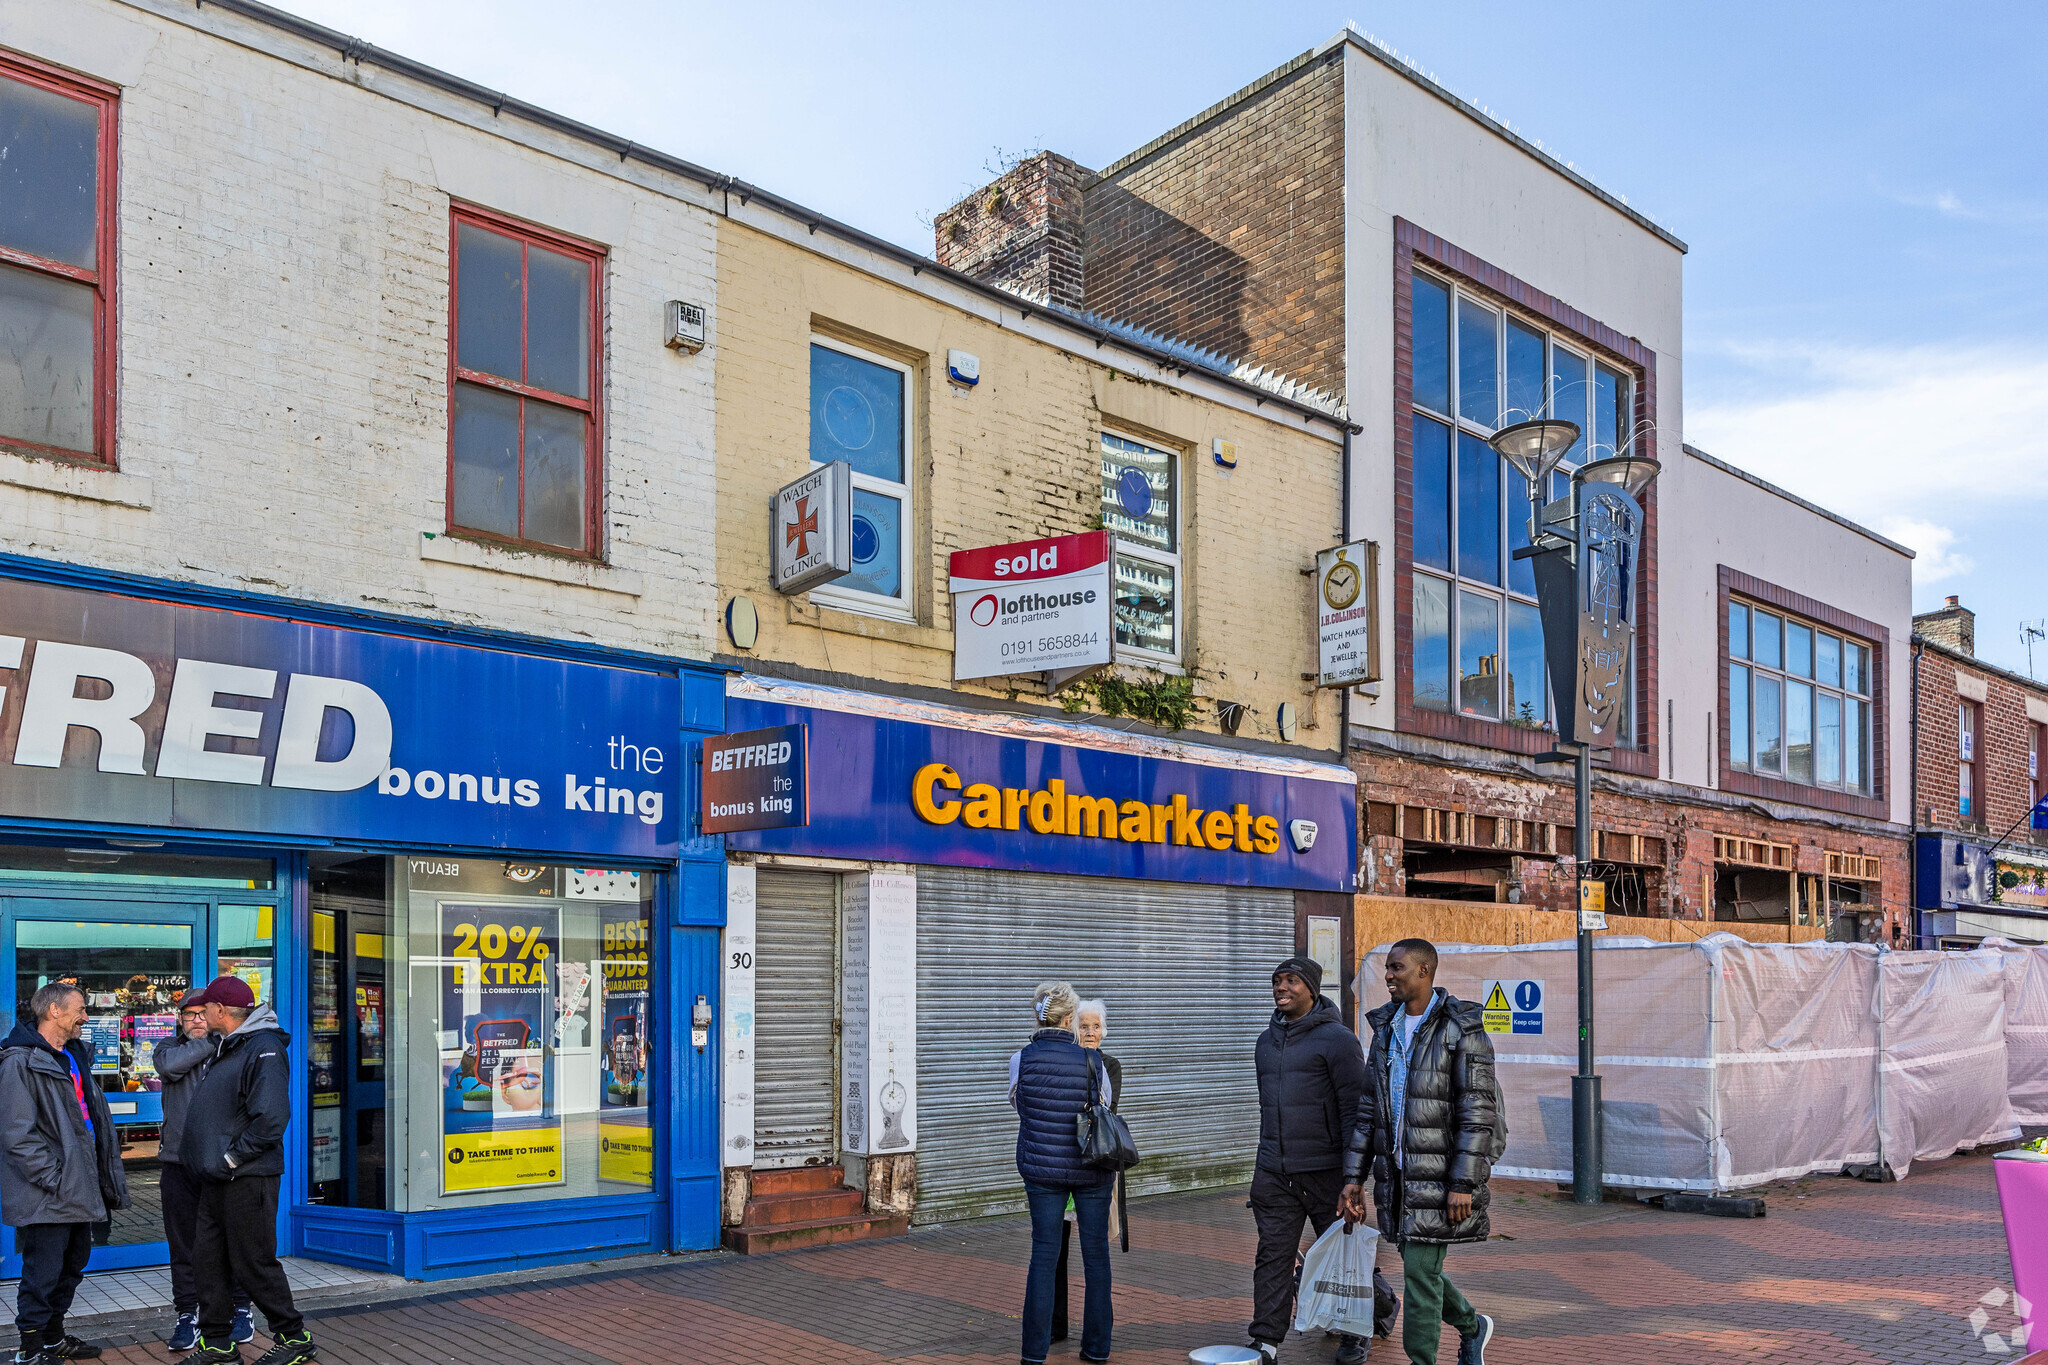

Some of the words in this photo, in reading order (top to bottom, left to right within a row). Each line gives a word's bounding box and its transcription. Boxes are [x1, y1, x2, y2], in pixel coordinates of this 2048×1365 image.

[680, 306, 701, 319] ABEL
[783, 474, 822, 503] WATCH
[788, 519, 815, 537] JEWELLERY
[783, 552, 822, 579] CLINIC
[994, 545, 1057, 576] sold
[1001, 590, 1096, 615] lofthouse
[1002, 615, 1018, 625] and
[1022, 610, 1060, 625] partners
[1130, 608, 1136, 618] &
[1139, 609, 1164, 624] WATCH
[1321, 631, 1343, 643] WATCH
[1345, 626, 1367, 638] MAKER
[1001, 640, 1032, 656] 0191
[1038, 632, 1098, 651] 5658844
[1337, 641, 1350, 651] AND
[1002, 650, 1090, 666] www.lofthouseandpartners.co.uk
[1331, 651, 1358, 664] JEWELLER
[1324, 672, 1336, 680] TEL
[1338, 667, 1365, 678] 565476
[607, 735, 664, 775] the
[711, 741, 791, 772] BETFRED
[378, 757, 540, 807] bonus
[565, 773, 663, 825] king
[773, 776, 792, 792] the
[710, 802, 754, 818] bonus
[760, 796, 792, 814] king
[912, 763, 1280, 855] Cardmarkets
[875, 894, 903, 903] Servicing
[904, 896, 911, 904] &
[856, 904, 868, 912] Straps
[882, 905, 905, 916] Repairs
[848, 916, 863, 924] Bracelet
[453, 923, 550, 960] 20%
[604, 920, 648, 952] BEST
[847, 936, 863, 944] Bracelet
[848, 944, 862, 953] Repairs
[604, 951, 648, 978] ODDS
[730, 952, 752, 969] 30
[453, 962, 549, 984] EXTRA
[855, 970, 869, 979] Repairs
[606, 979, 648, 991] GUARANTEED
[847, 985, 857, 993] Straps
[856, 1005, 868, 1013] Straps
[849, 1029, 862, 1037] Straps
[483, 1038, 519, 1047] BETFRED
[844, 1040, 853, 1048] Gold
[482, 1056, 520, 1065] FESTIVAL
[849, 1050, 861, 1058] Straps
[492, 1148, 513, 1157] TIME
[515, 1147, 527, 1155] TO
[528, 1146, 555, 1154] THINK
[610, 1142, 620, 1150] TAKE
[631, 1144, 638, 1152] TO
